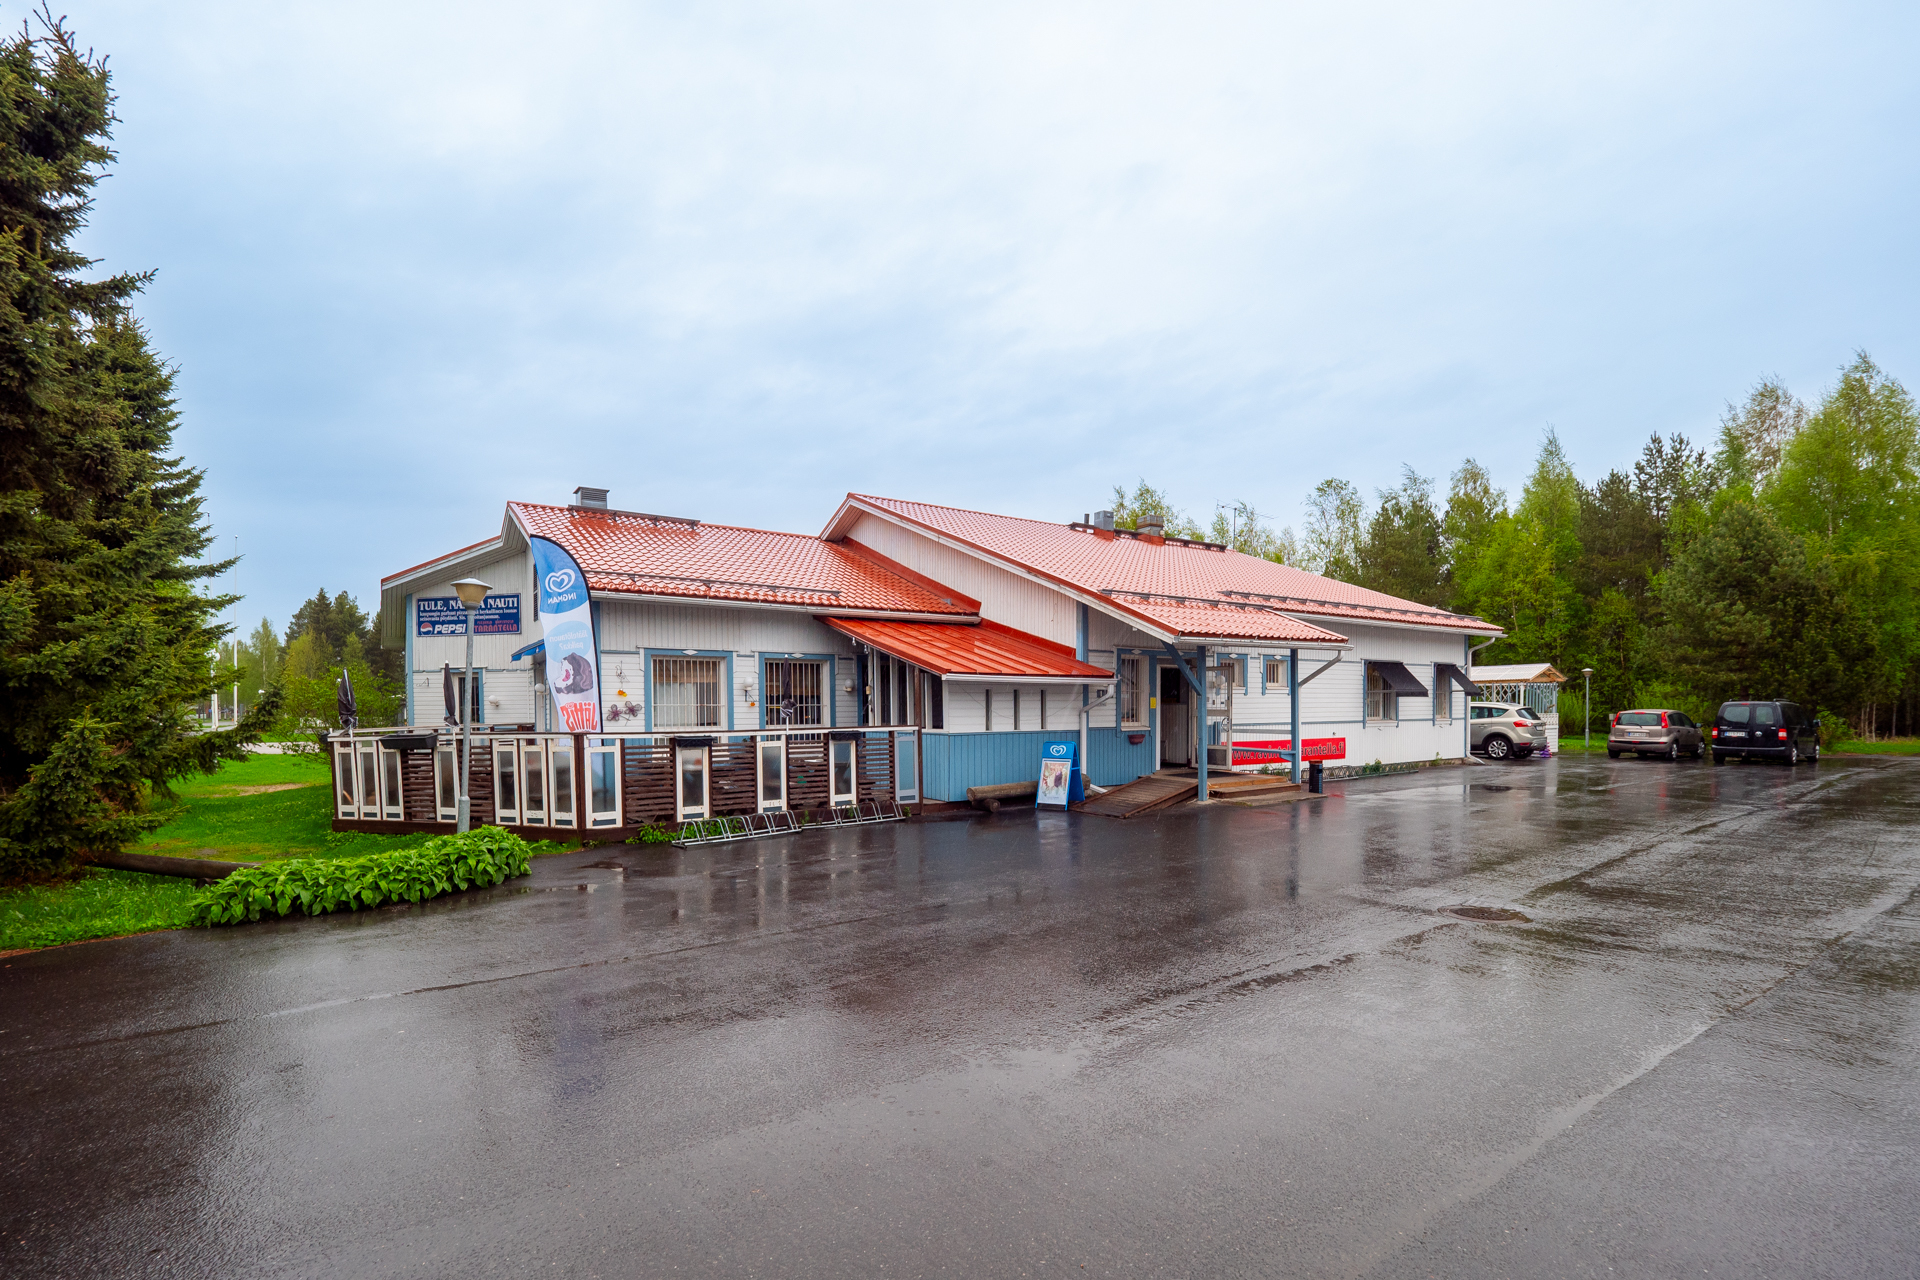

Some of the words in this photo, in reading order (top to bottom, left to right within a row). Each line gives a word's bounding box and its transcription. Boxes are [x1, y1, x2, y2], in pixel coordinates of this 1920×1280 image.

[418, 600, 447, 611] TULE,
[449, 598, 466, 610] NÄ
[487, 597, 518, 608] NAUTI
[434, 623, 467, 634] PEPSI
[474, 623, 518, 633] TARANTELLA
